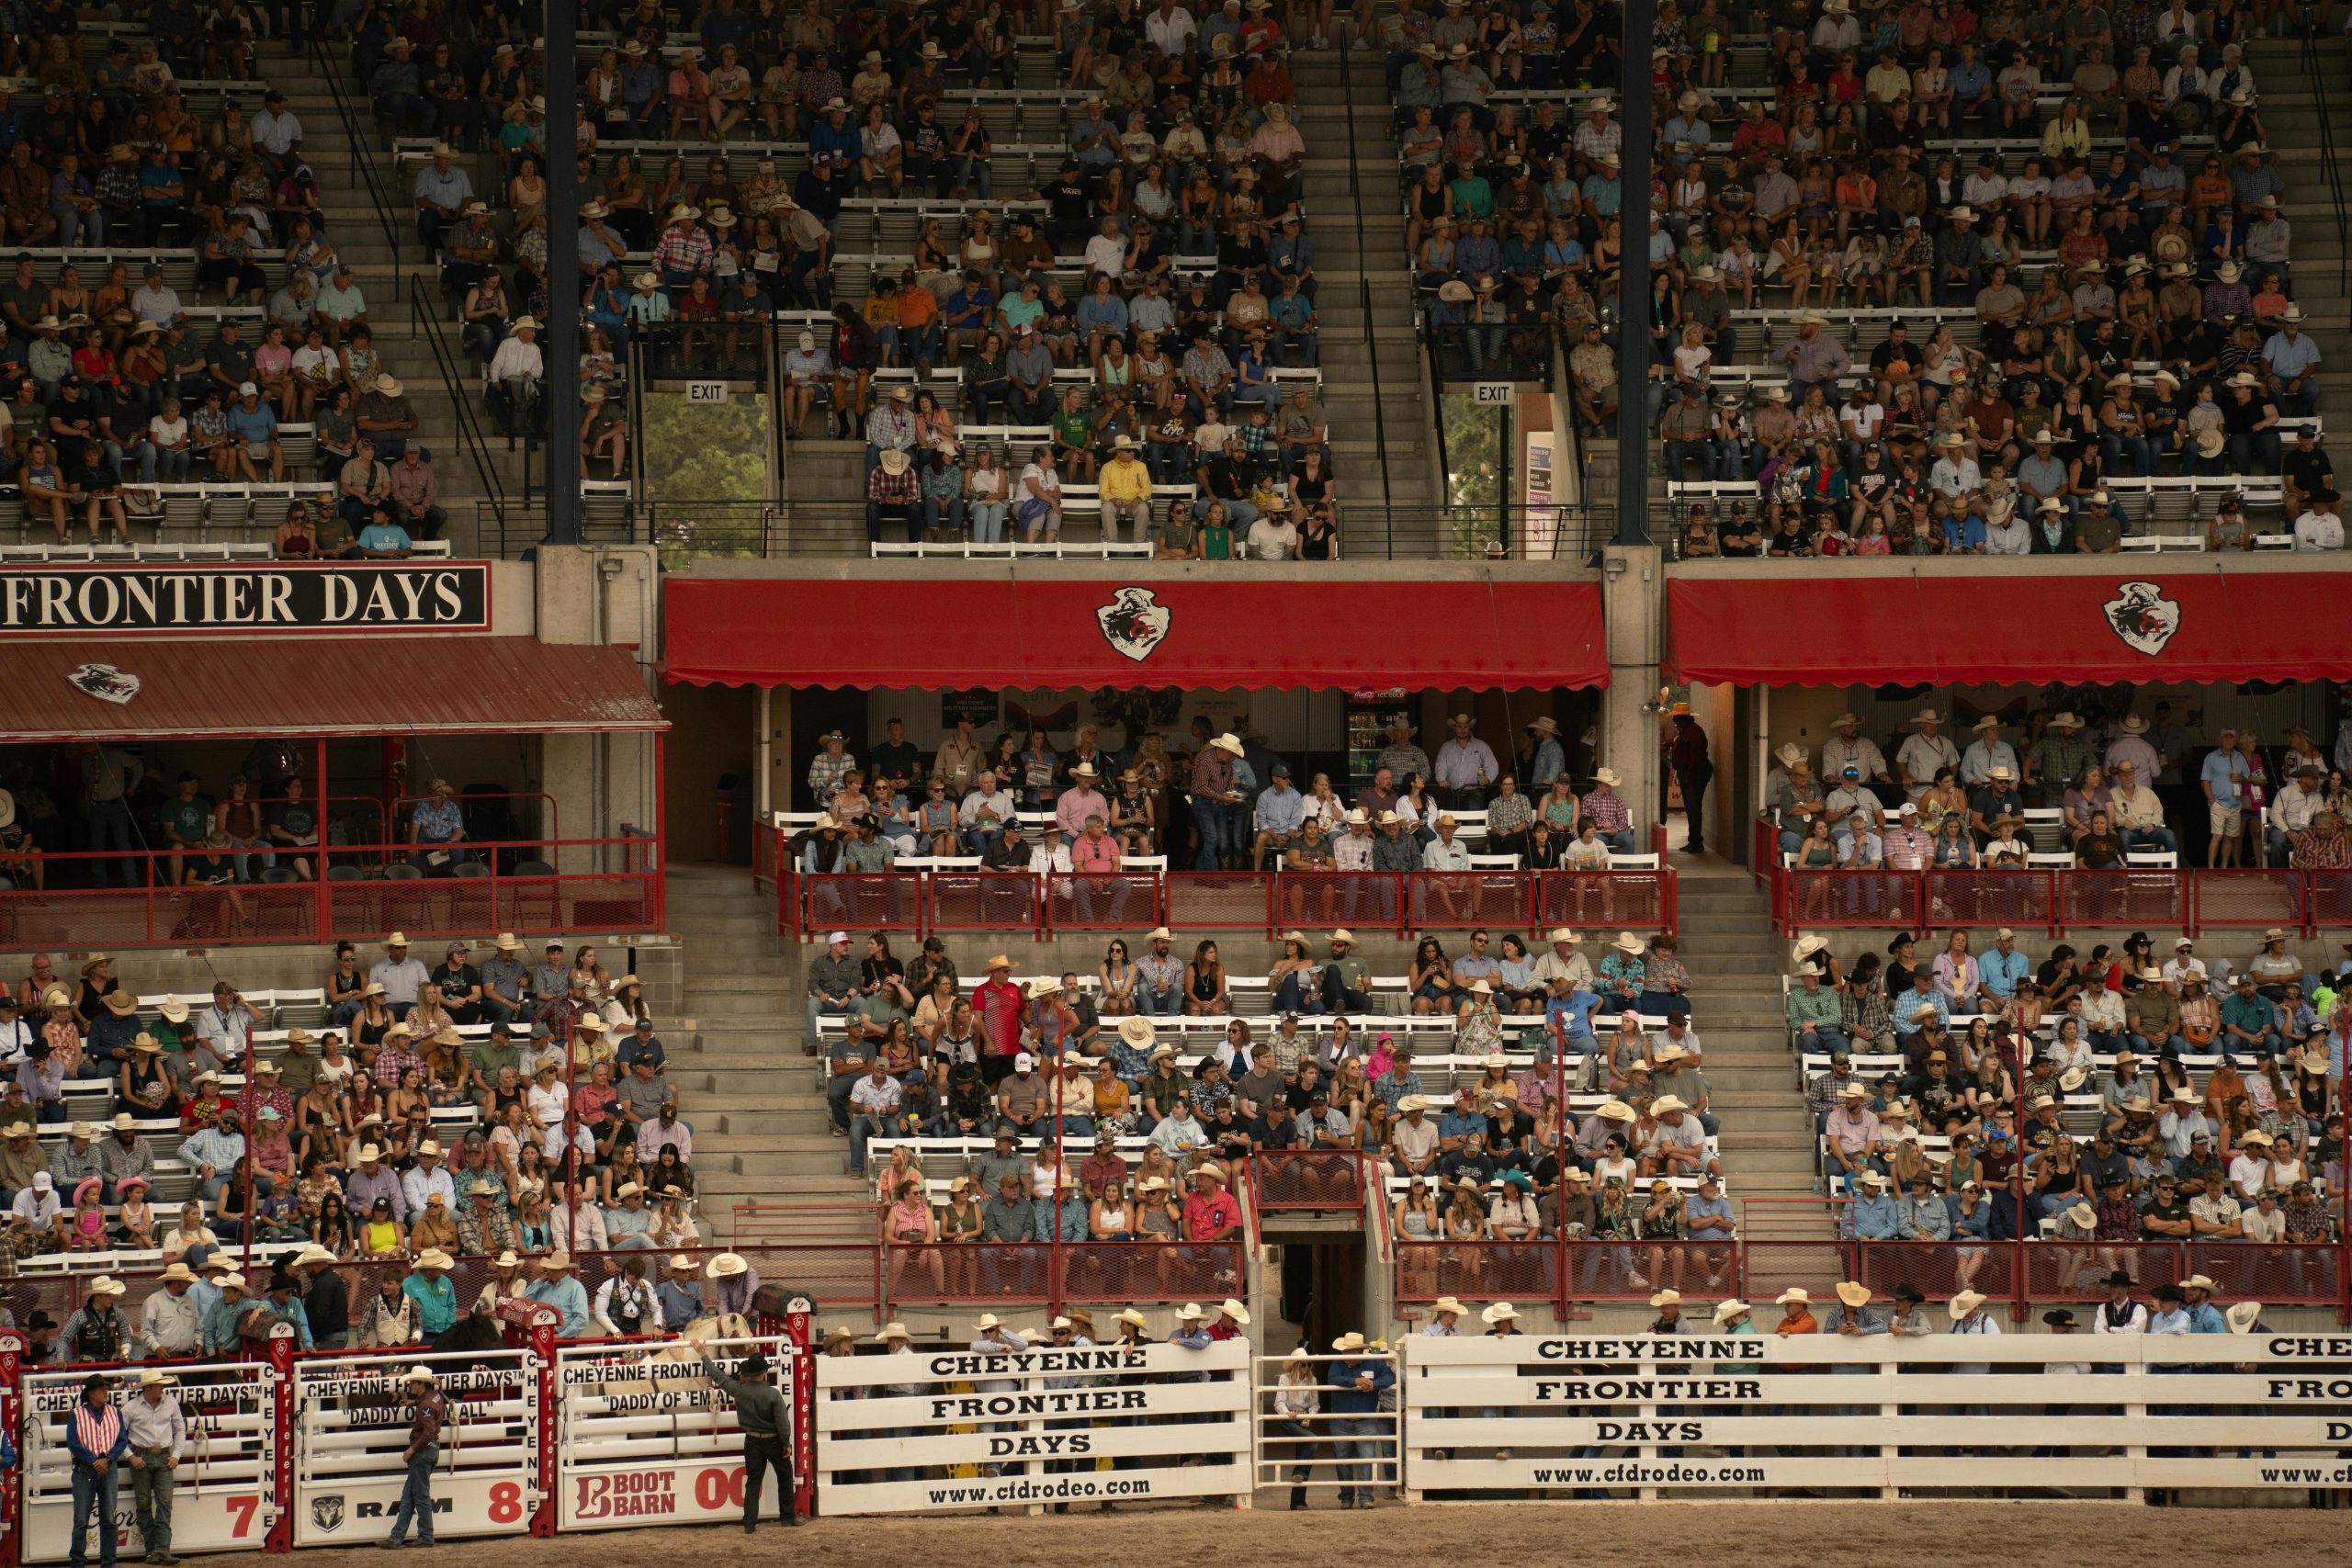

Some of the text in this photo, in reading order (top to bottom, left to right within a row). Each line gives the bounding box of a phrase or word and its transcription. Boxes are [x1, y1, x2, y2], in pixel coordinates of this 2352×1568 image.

[692, 385, 721, 400] EXIT
[1479, 386, 1509, 401] EXIT
[1, 571, 462, 626] FRONTIER DAYS
[1537, 1340, 1764, 1359] CHEYENNE
[564, 1364, 646, 1384] CHEYENNE
[930, 1349, 1147, 1376] CHEYENNE
[307, 1378, 390, 1398] CHEYENNE
[662, 1391, 681, 1407] OF
[1535, 1381, 1762, 1400] FRONTIER
[932, 1390, 1148, 1419] FRONTIER
[526, 1353, 538, 1514] CHEYENNE
[1597, 1422, 1703, 1441] DAYS
[263, 1365, 276, 1529] CHEYENNE
[989, 1434, 1091, 1457] DAYS
[613, 1471, 676, 1495] BOOT
[1533, 1463, 1766, 1483] www.cfdrodeo.com
[487, 1481, 523, 1524] 8
[929, 1478, 1150, 1504] www.cfdrodeo.com
[613, 1493, 676, 1517] BARN
[226, 1495, 260, 1539] 7
